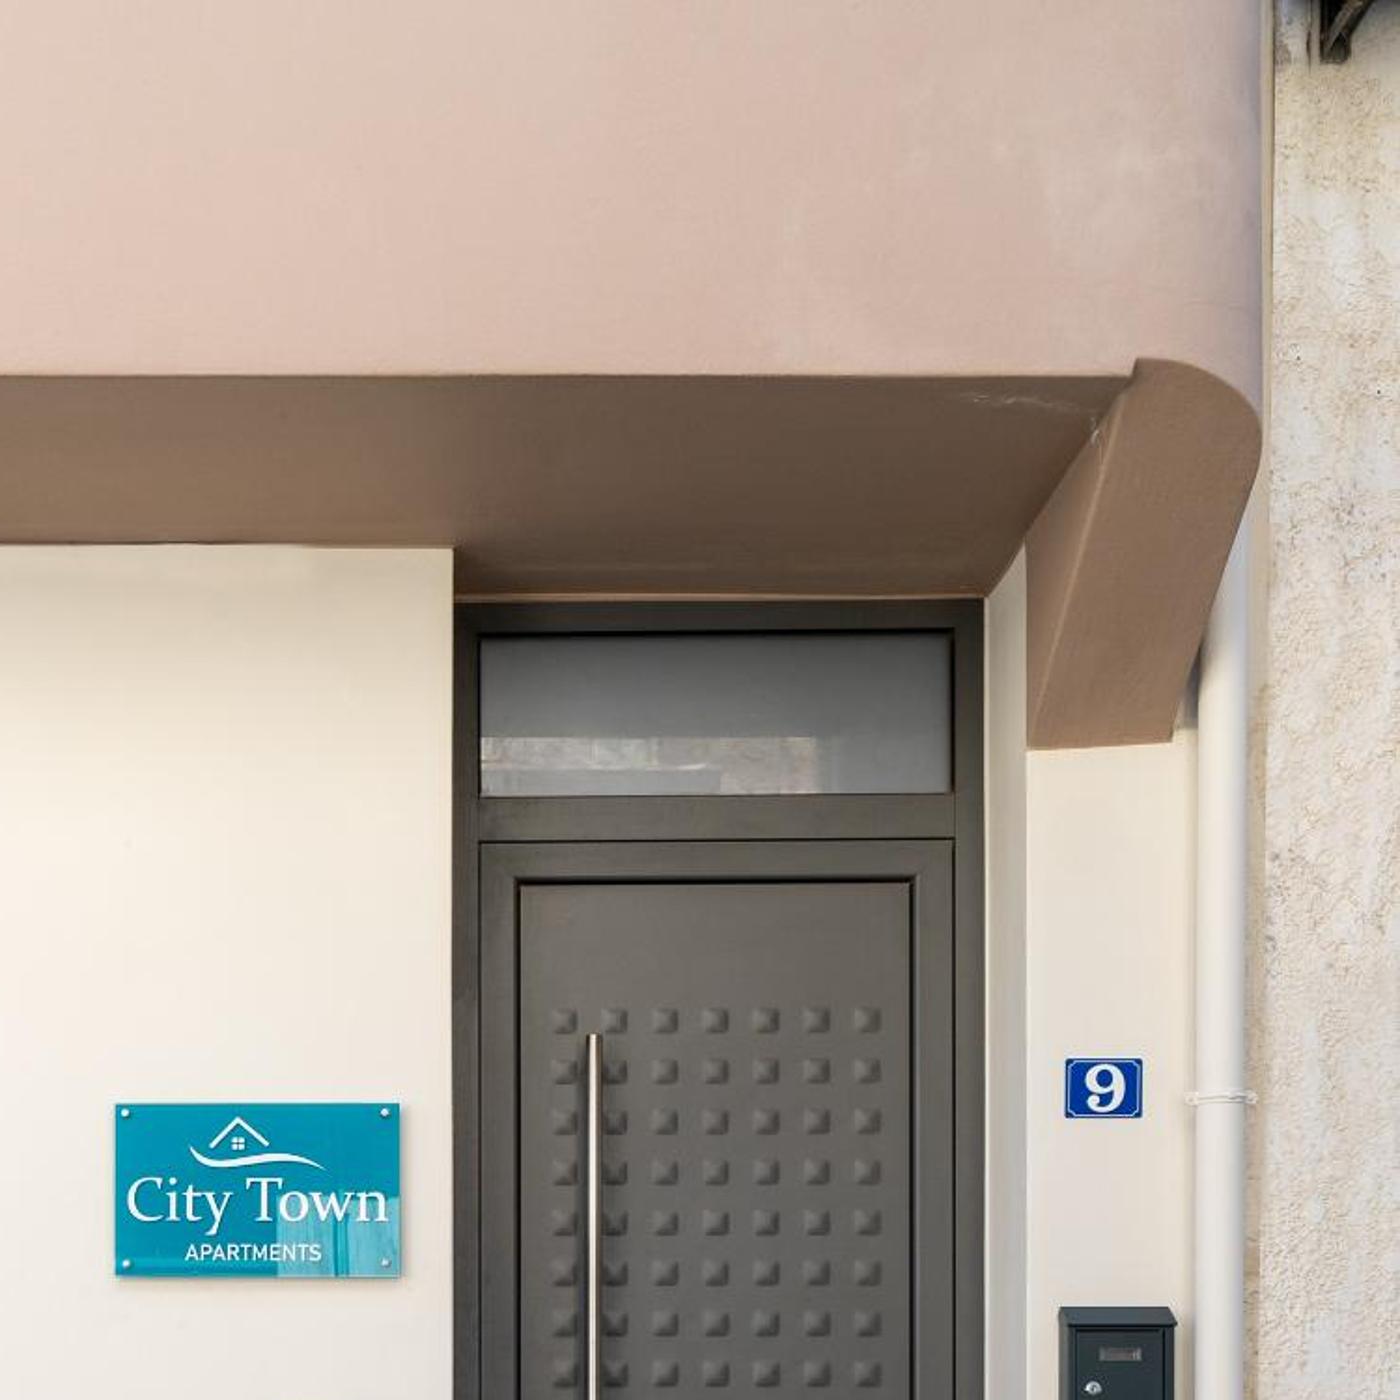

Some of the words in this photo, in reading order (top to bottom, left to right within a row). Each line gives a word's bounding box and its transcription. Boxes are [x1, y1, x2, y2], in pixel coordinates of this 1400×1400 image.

[1085, 1063, 1126, 1113] 9
[126, 1176, 233, 1236] City
[245, 1177, 389, 1222] Town
[184, 1243, 322, 1262] APARTMENTS
